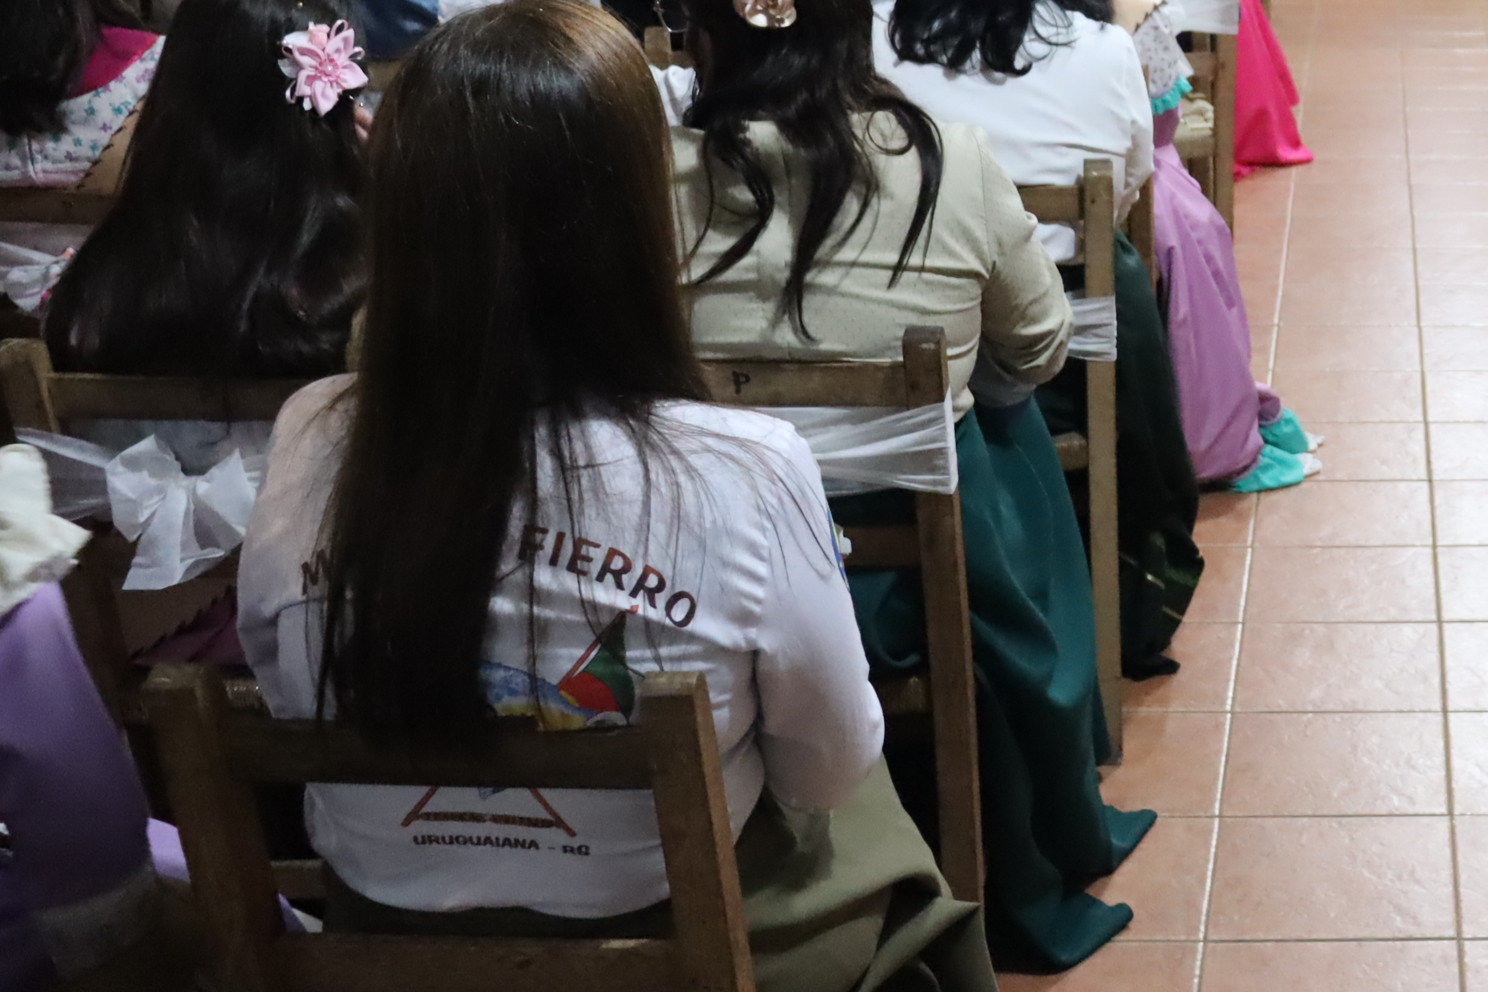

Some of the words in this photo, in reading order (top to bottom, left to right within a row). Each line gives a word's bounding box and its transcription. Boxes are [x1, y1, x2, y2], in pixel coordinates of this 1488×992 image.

[732, 370, 751, 395] P
[518, 524, 697, 628] FIERRO
[413, 834, 540, 850] URUGUAIANA
